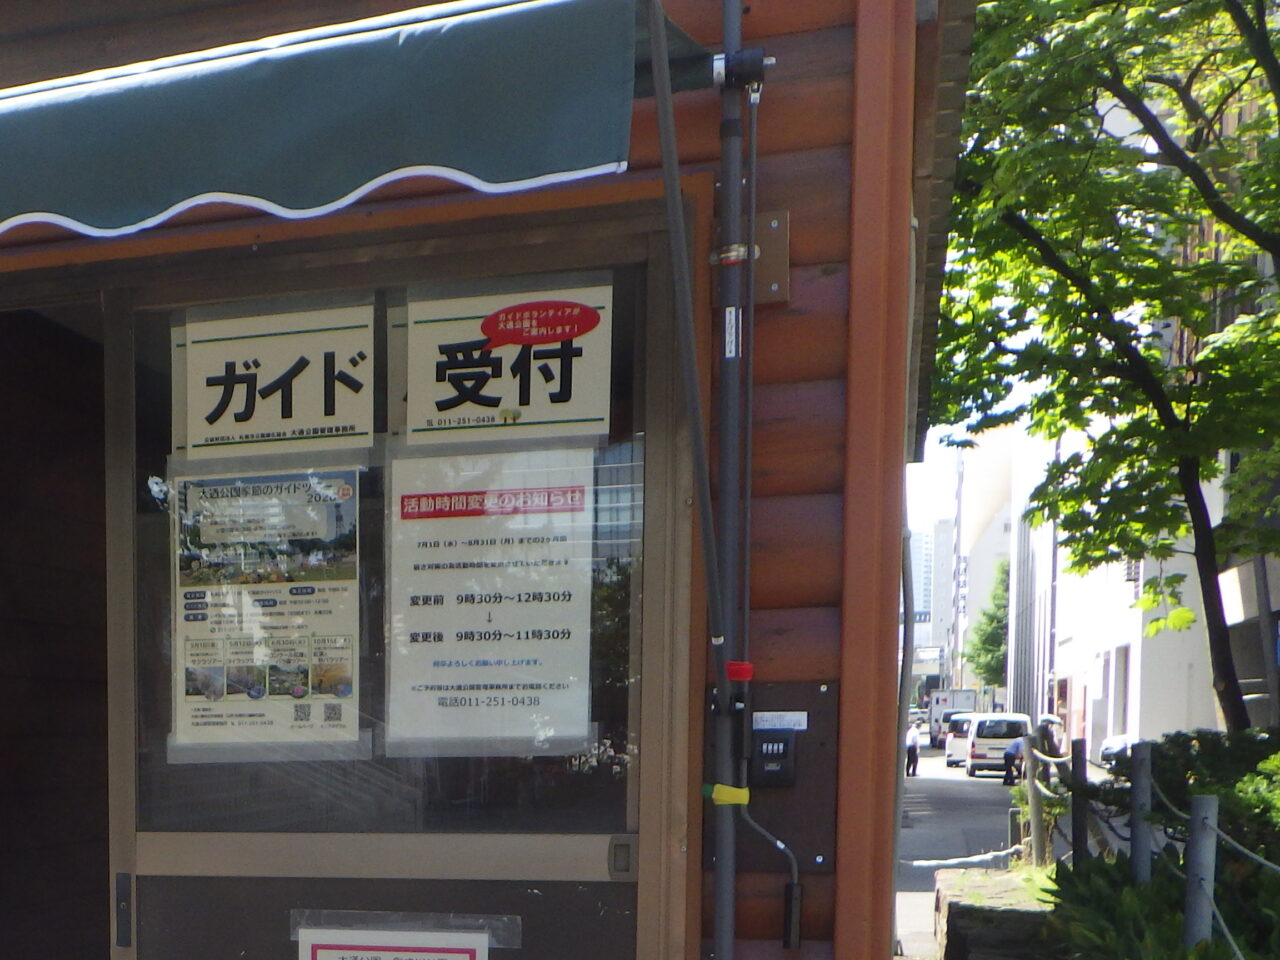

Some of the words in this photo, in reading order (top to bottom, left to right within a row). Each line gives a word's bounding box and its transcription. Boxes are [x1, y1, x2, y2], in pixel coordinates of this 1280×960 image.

[435, 337, 583, 412] 受付
[205, 351, 367, 425] ガイド
[437, 416, 496, 426] 011-251-0438
[403, 491, 582, 513] 活動時間変更のお知らせ
[410, 594, 444, 606] 変更前
[409, 631, 444, 643] 変更後
[438, 696, 540, 708] 電話011-251-0438
